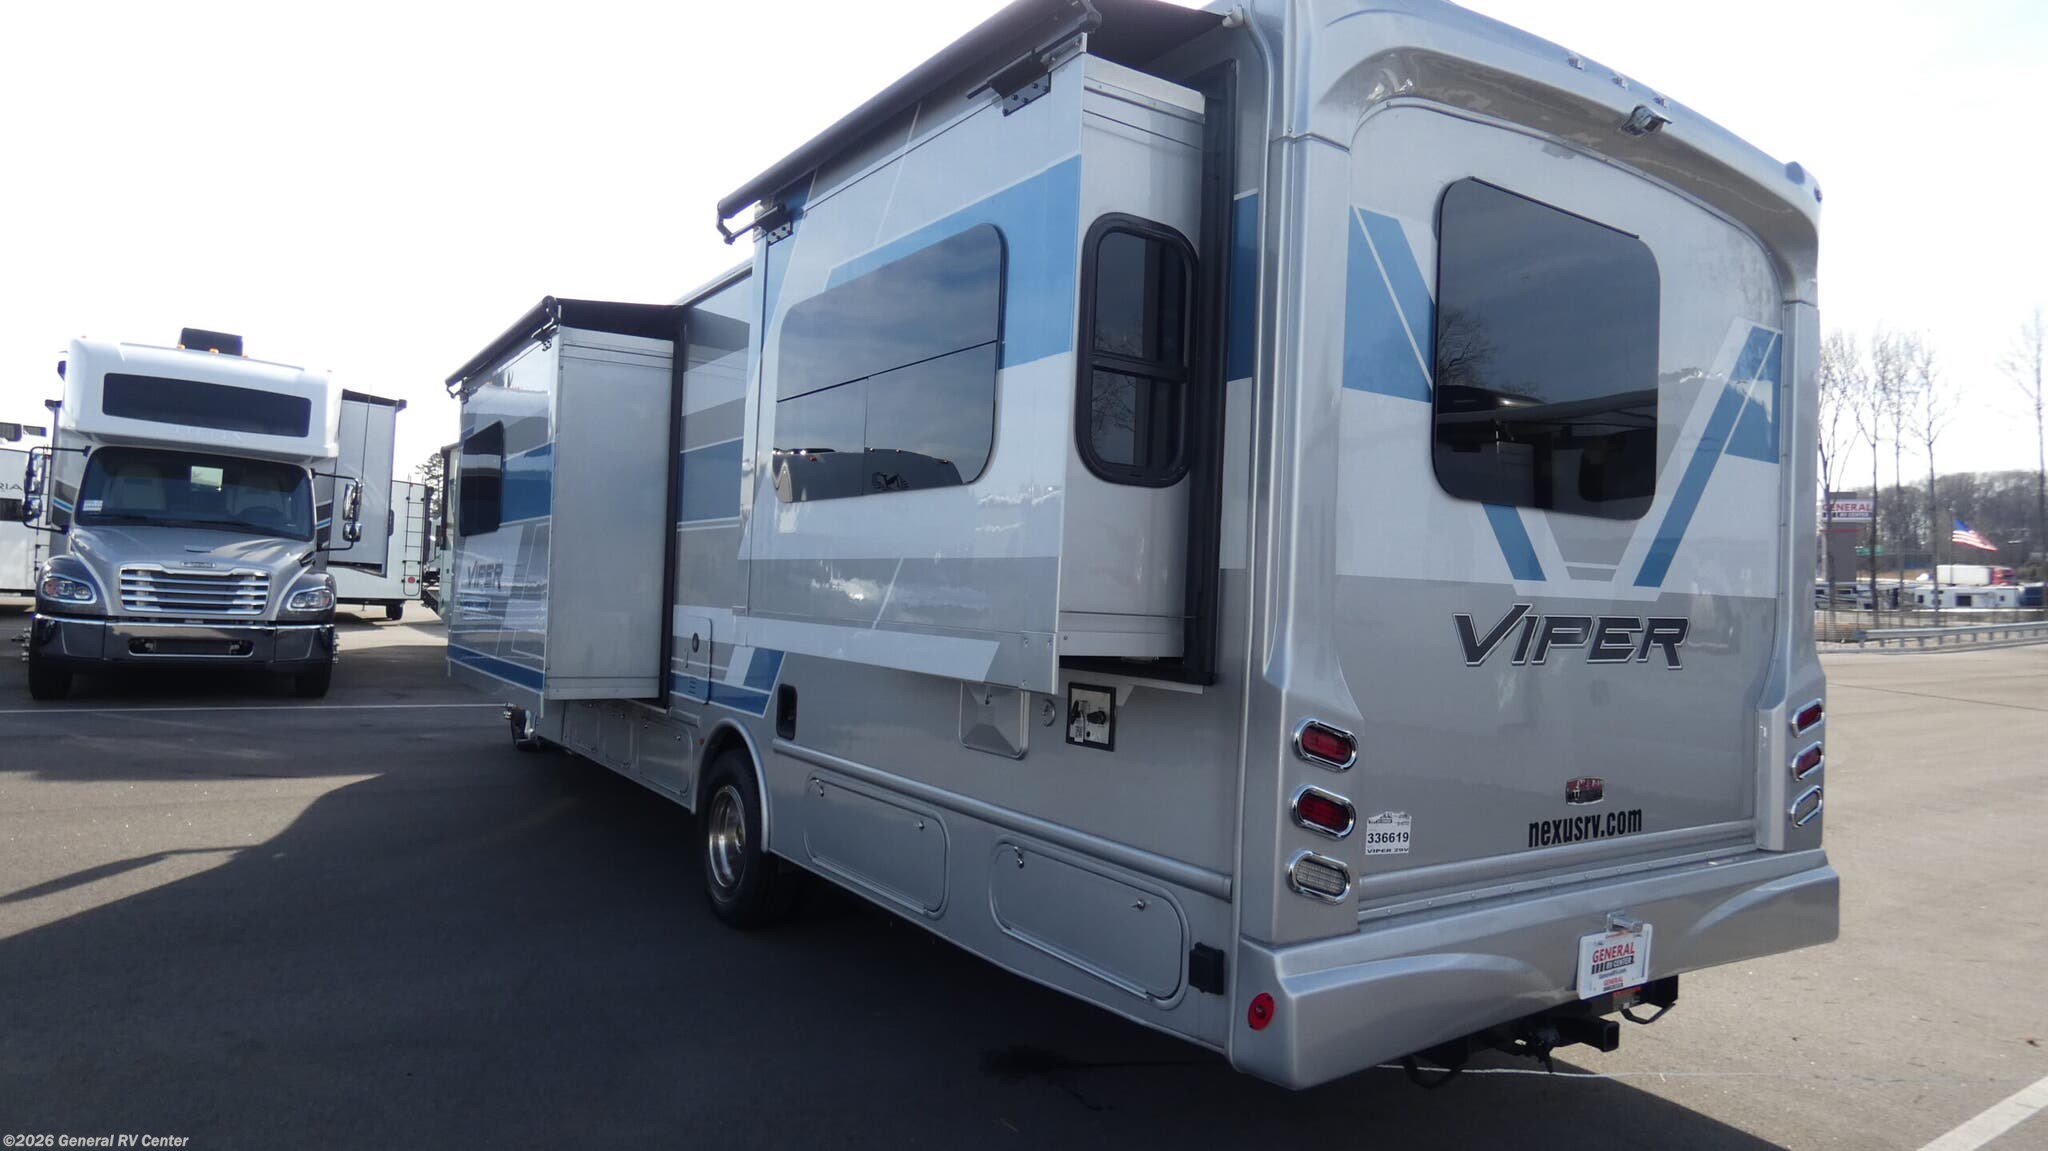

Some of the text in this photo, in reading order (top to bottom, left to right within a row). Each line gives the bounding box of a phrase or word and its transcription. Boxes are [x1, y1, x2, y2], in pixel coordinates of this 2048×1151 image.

[1452, 603, 1690, 670] VIPER
[1367, 832, 1409, 844] 336619
[1528, 808, 1643, 848] nexusrv.com
[1592, 942, 1635, 963] GENERAL
